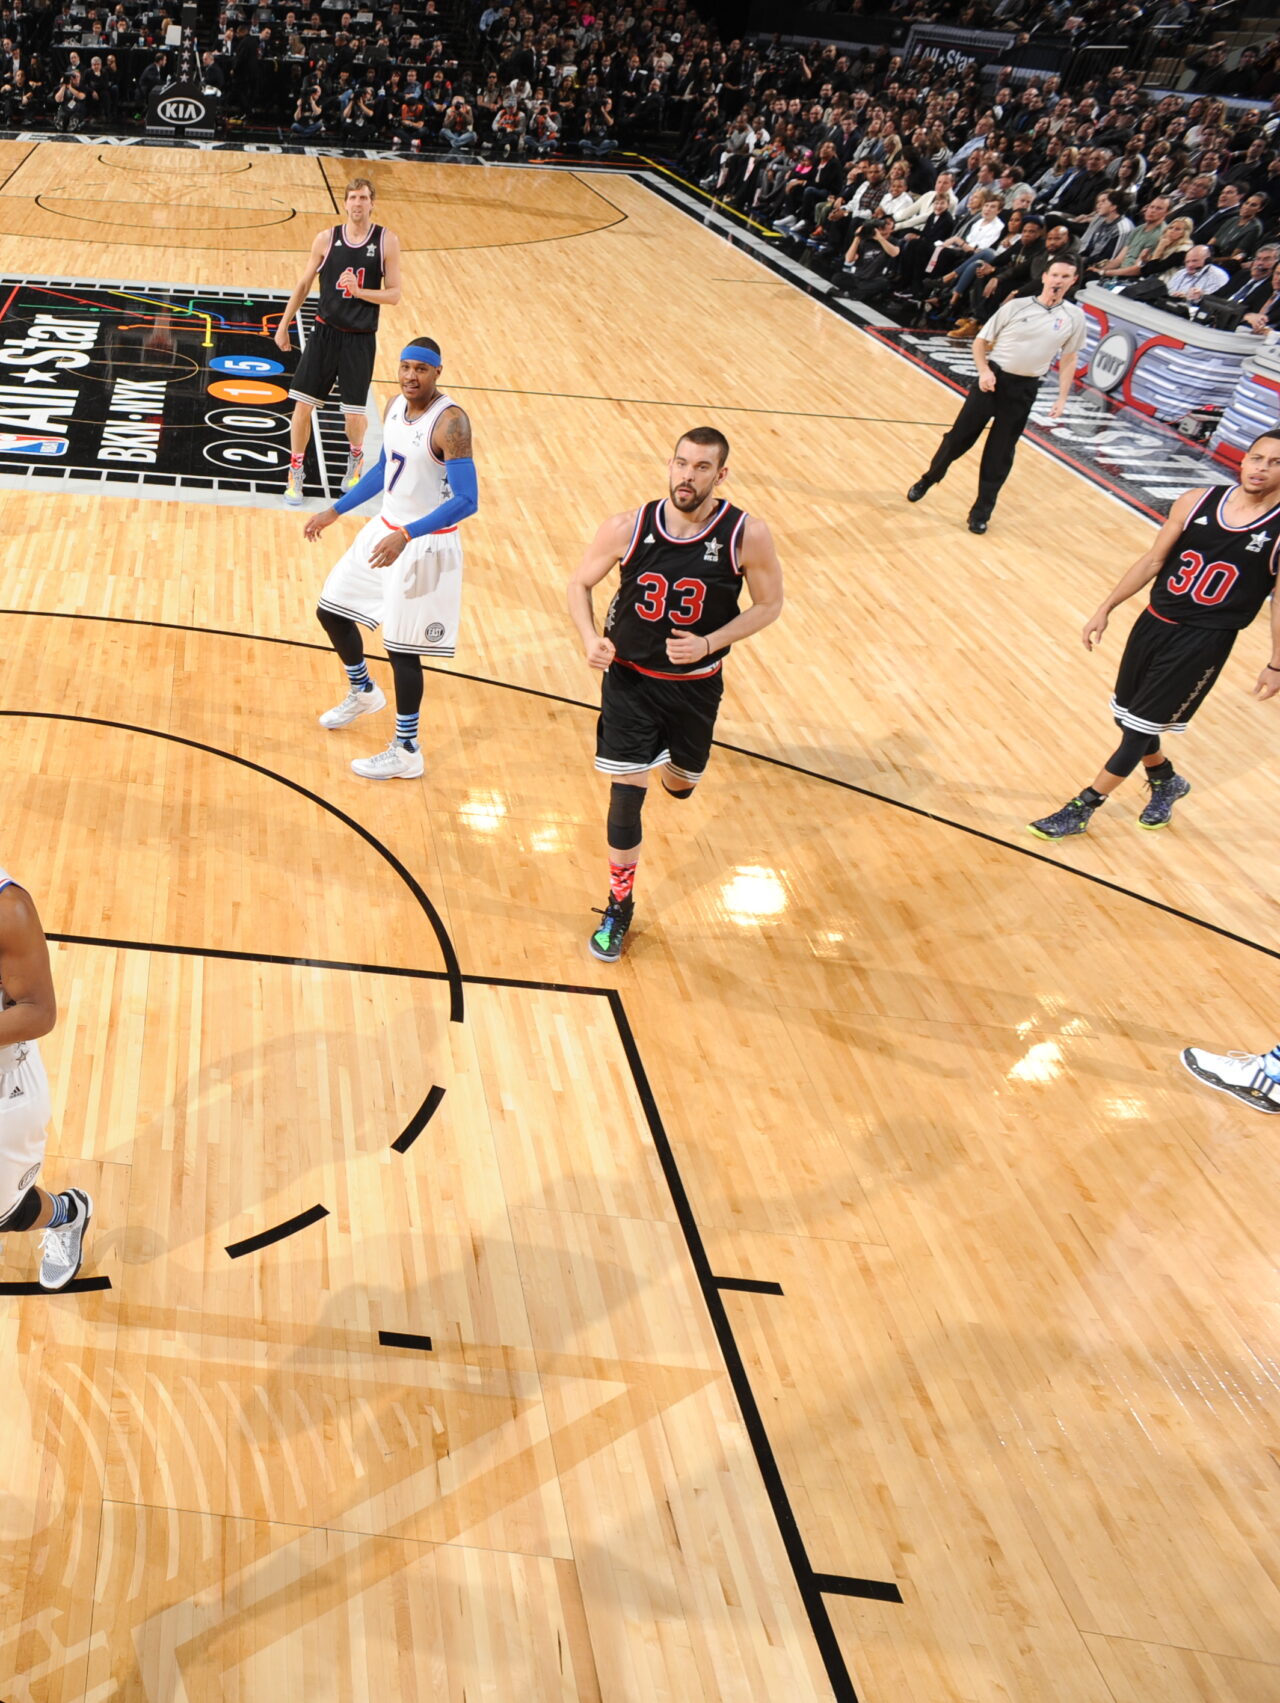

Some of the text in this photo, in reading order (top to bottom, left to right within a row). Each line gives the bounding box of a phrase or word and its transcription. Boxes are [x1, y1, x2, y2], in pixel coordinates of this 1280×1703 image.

[165, 102, 198, 120] KIA
[184, 141, 408, 162] YORK
[336, 267, 365, 298] 41
[1096, 351, 1124, 375] TNT
[388, 449, 407, 495] 7
[1168, 549, 1239, 605] 30
[635, 572, 707, 625] 33
